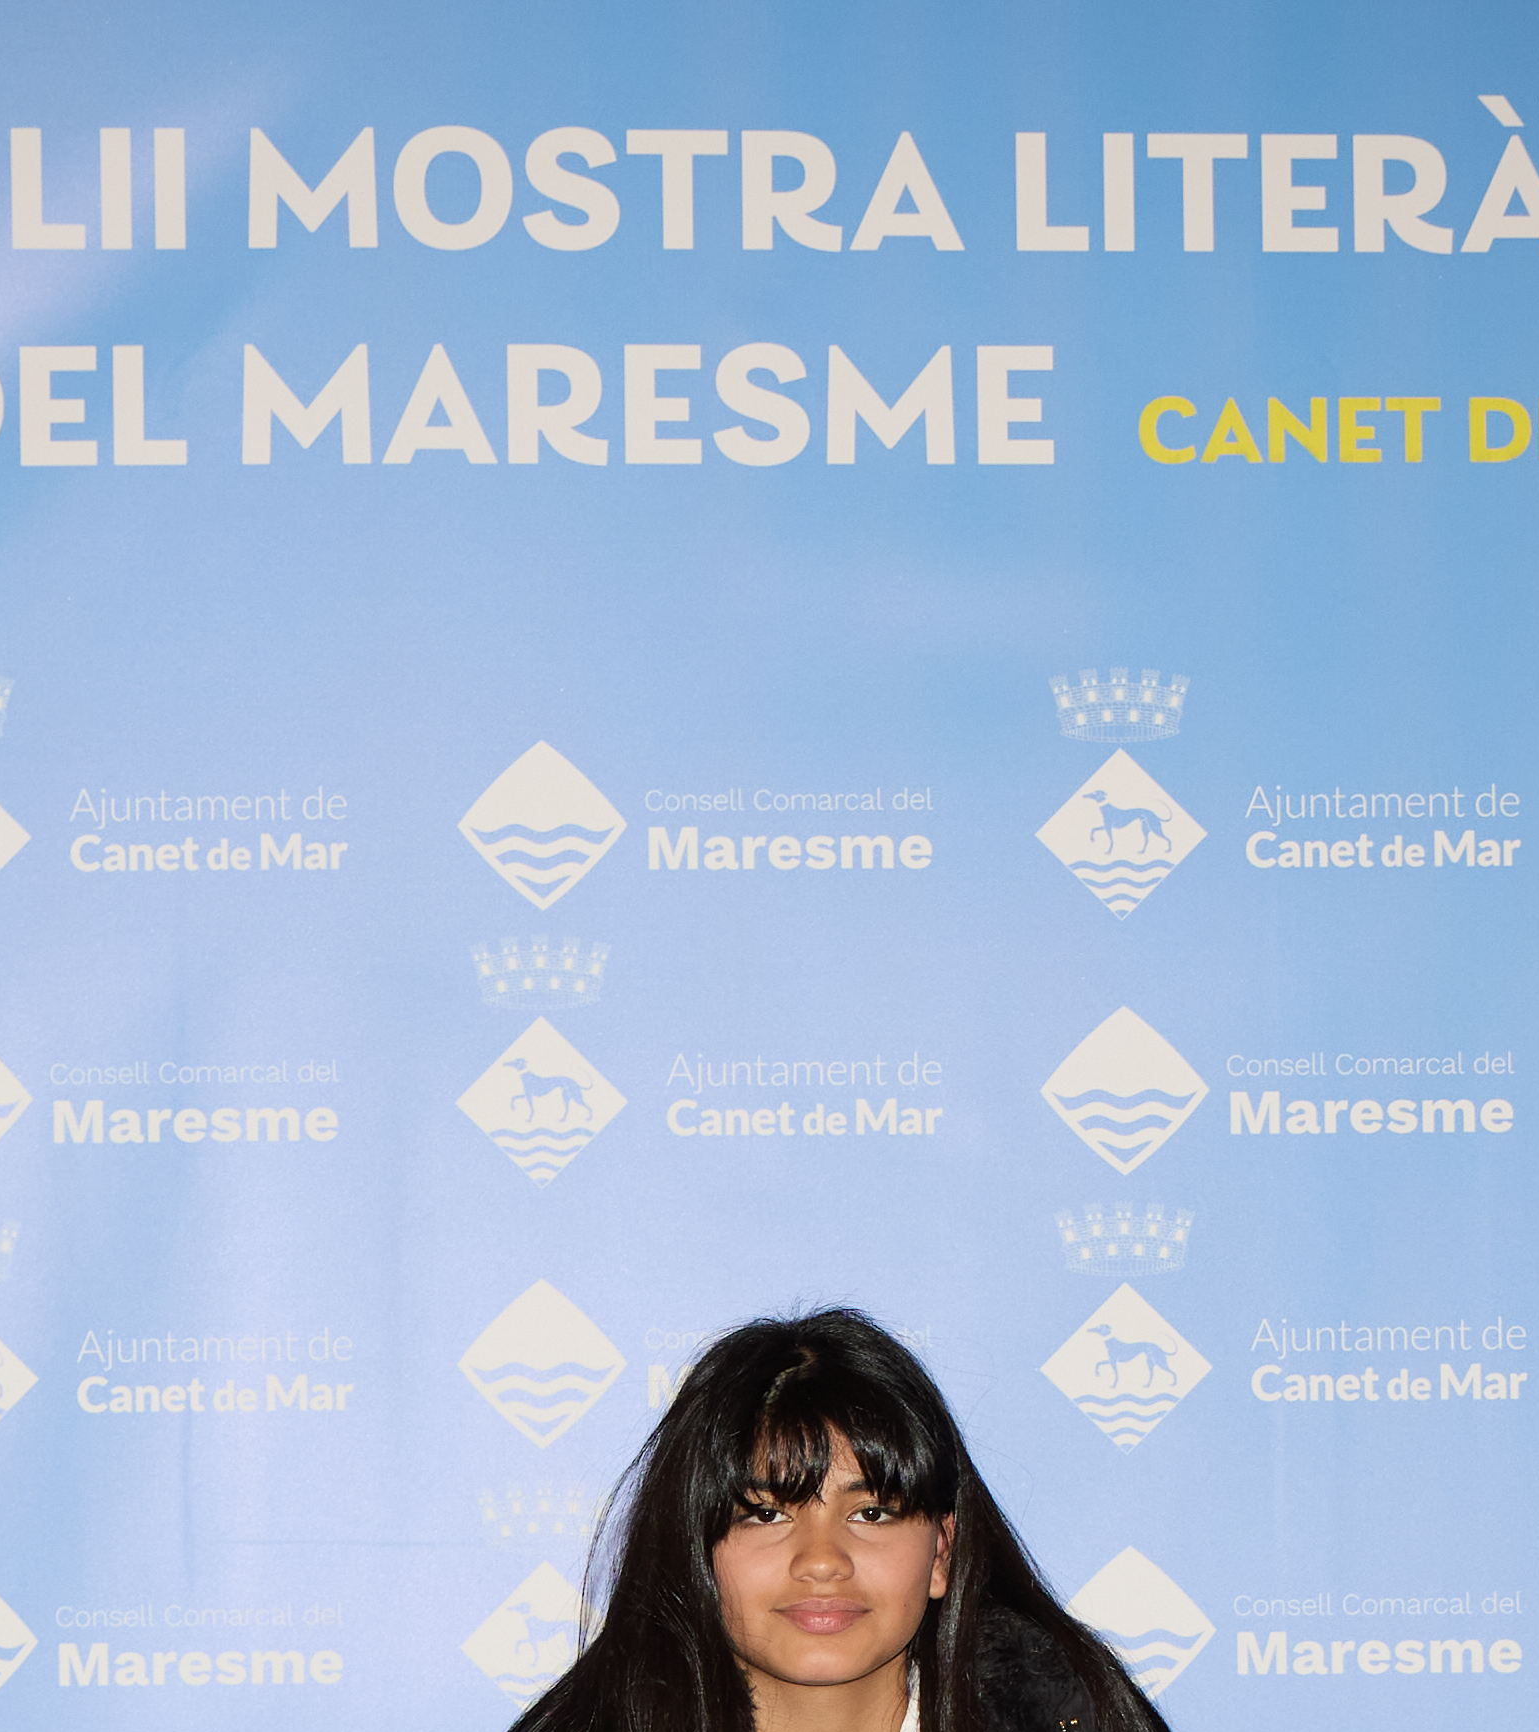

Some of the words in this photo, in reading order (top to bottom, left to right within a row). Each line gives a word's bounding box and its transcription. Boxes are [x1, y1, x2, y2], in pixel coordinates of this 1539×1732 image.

[247, 124, 966, 253] MOSTRA
[241, 341, 1056, 467] MARESME
[1138, 395, 1441, 465] CANET
[69, 788, 292, 830] Ajuntament
[302, 785, 348, 821] de
[69, 833, 200, 873] Canet
[206, 837, 253, 872] de
[259, 832, 349, 871] Mar
[1226, 1052, 1327, 1077] Consell
[1335, 1051, 1465, 1076] Comarcal
[1473, 1051, 1515, 1075] del
[1229, 1090, 1515, 1135] Maresme
[1251, 1318, 1472, 1360] Ajuntament
[1481, 1316, 1527, 1351] de
[1250, 1363, 1381, 1402] Canet
[1386, 1367, 1432, 1402] de
[1439, 1362, 1529, 1401] Mar
